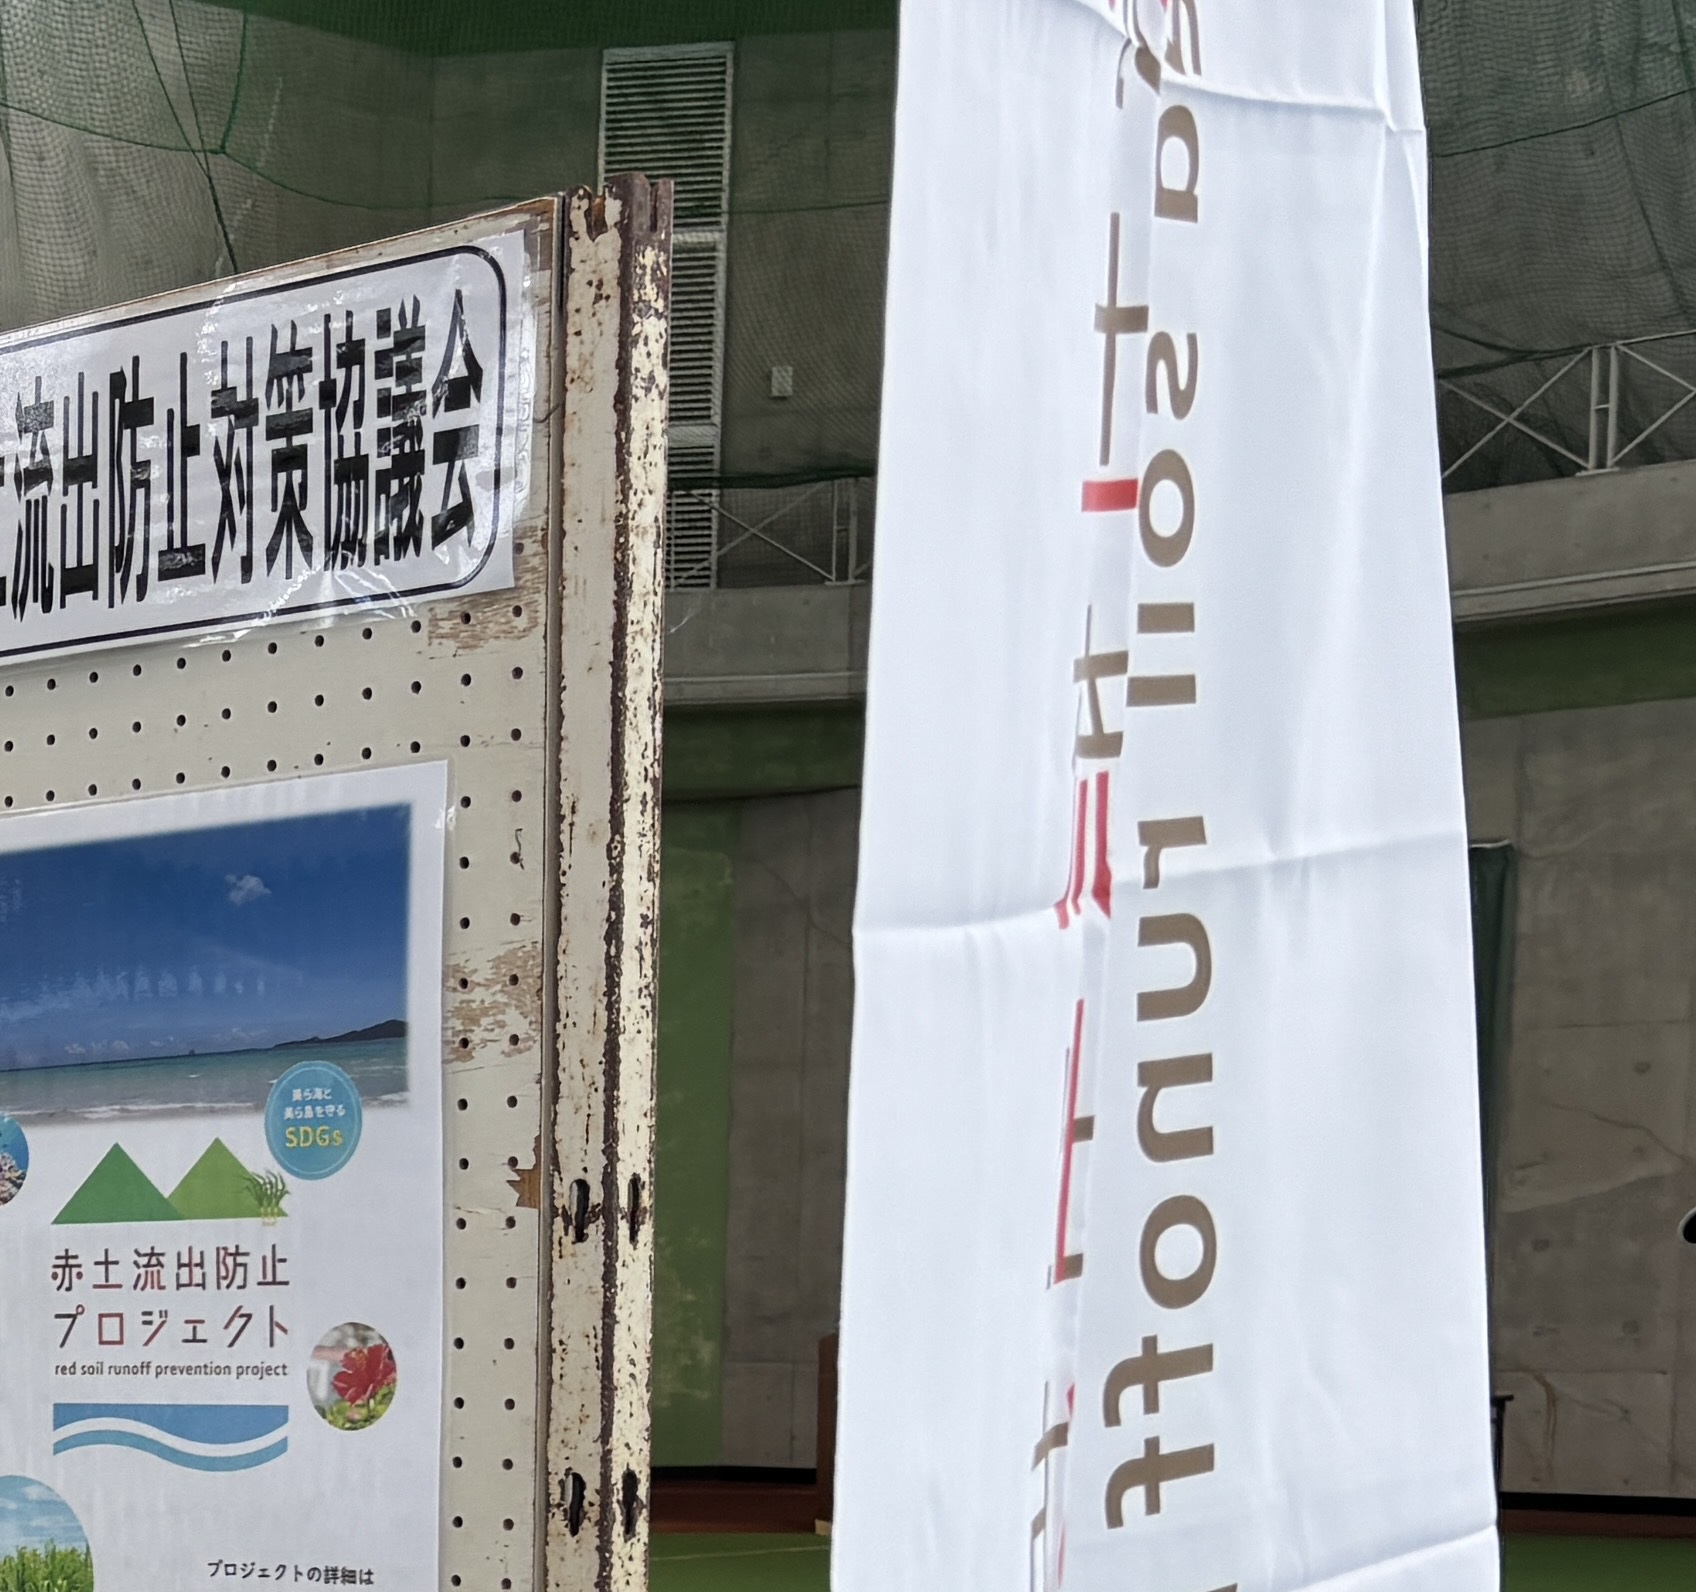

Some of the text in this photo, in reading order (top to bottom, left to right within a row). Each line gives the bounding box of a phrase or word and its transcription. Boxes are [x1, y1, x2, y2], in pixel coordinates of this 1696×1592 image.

[285, 1125, 343, 1148] SDGs
[51, 1245, 290, 1293] 赤土流出防止
[52, 1305, 290, 1348] プロジェクト
[54, 1361, 289, 1380] red soil runoff prevention project
[208, 1558, 374, 1587] プロジェクトの詳細は
